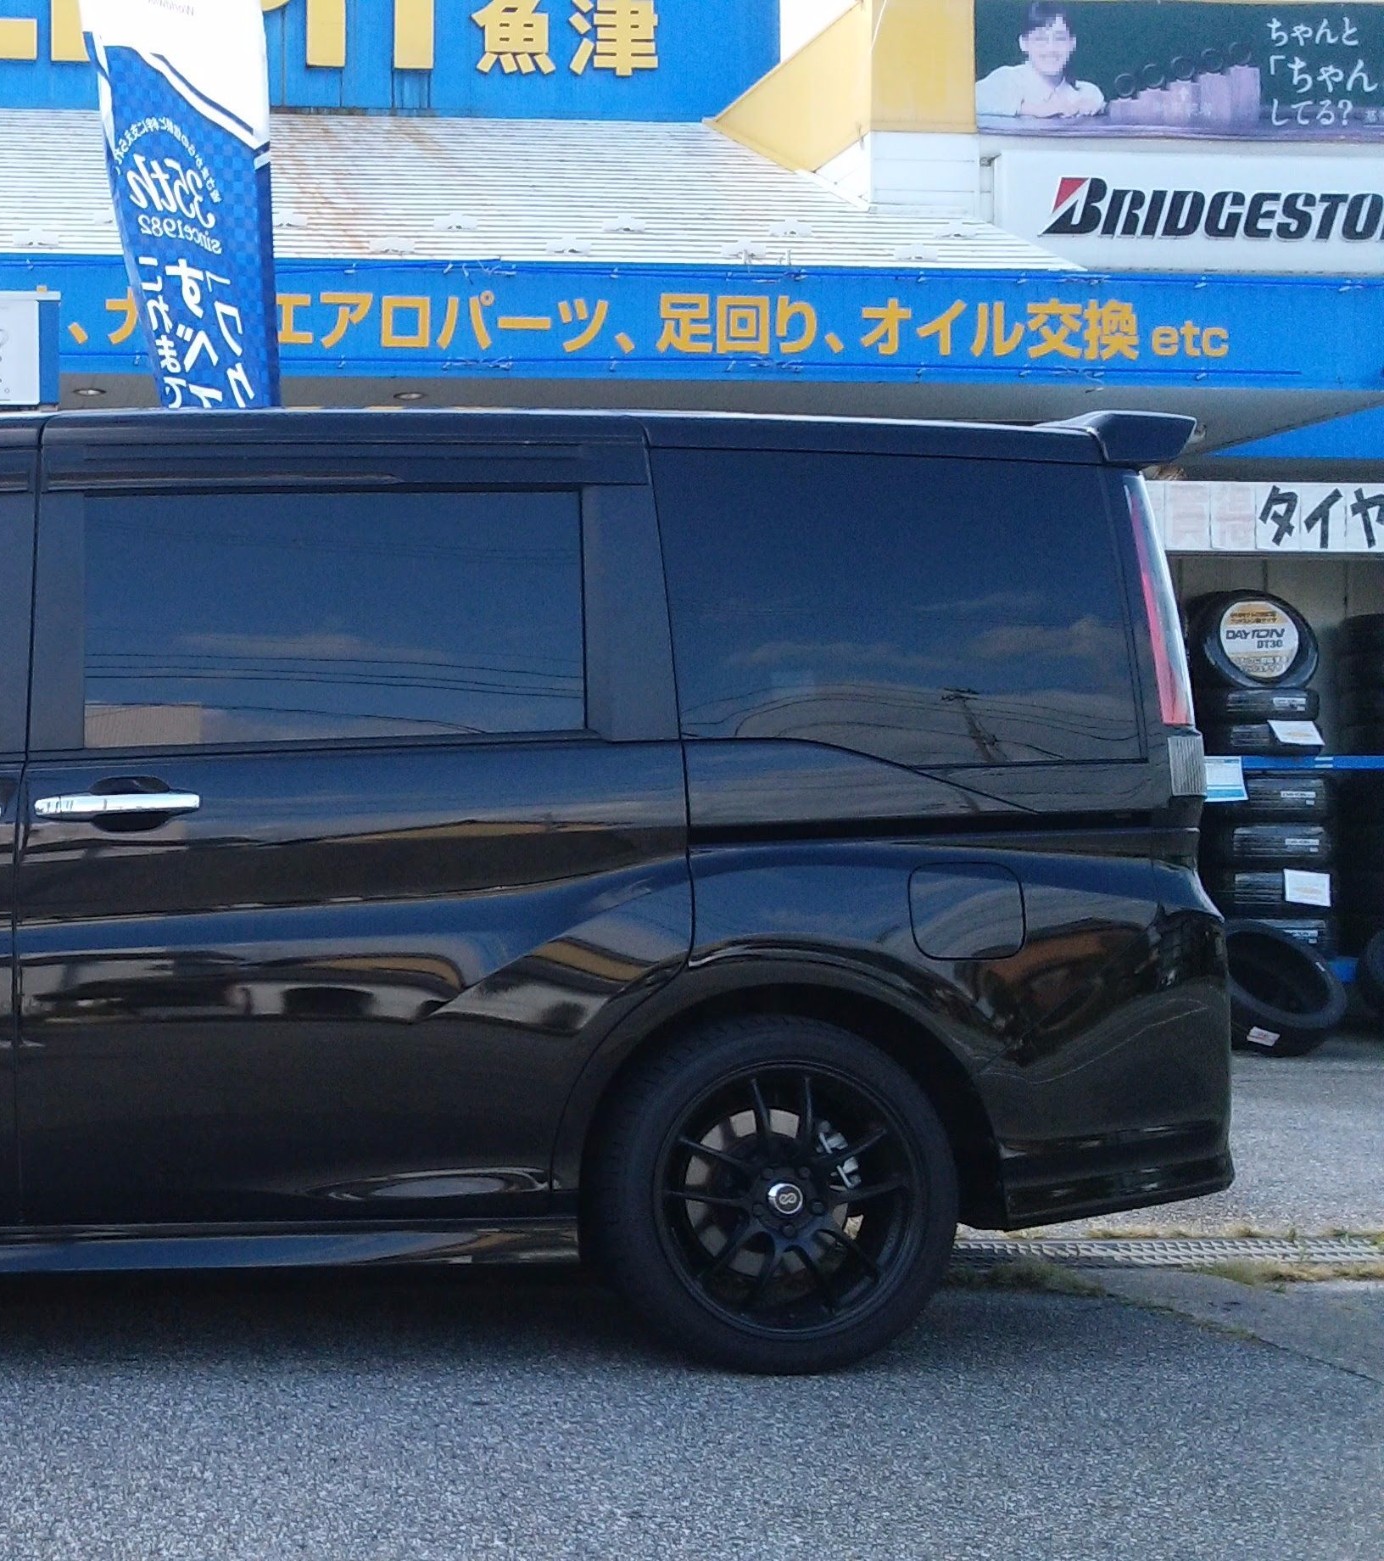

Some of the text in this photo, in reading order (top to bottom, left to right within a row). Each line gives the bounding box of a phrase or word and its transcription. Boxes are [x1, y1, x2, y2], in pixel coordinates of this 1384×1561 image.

[1266, 17, 1359, 47] ちゃんと
[1269, 54, 1379, 94] 「ちゃん
[1270, 98, 1354, 126] してる?
[1038, 177, 1384, 241] BRIDGESTO
[1150, 323, 1229, 359] etc
[1258, 484, 1384, 549] タイヤ
[1225, 627, 1286, 640] DAYTON
